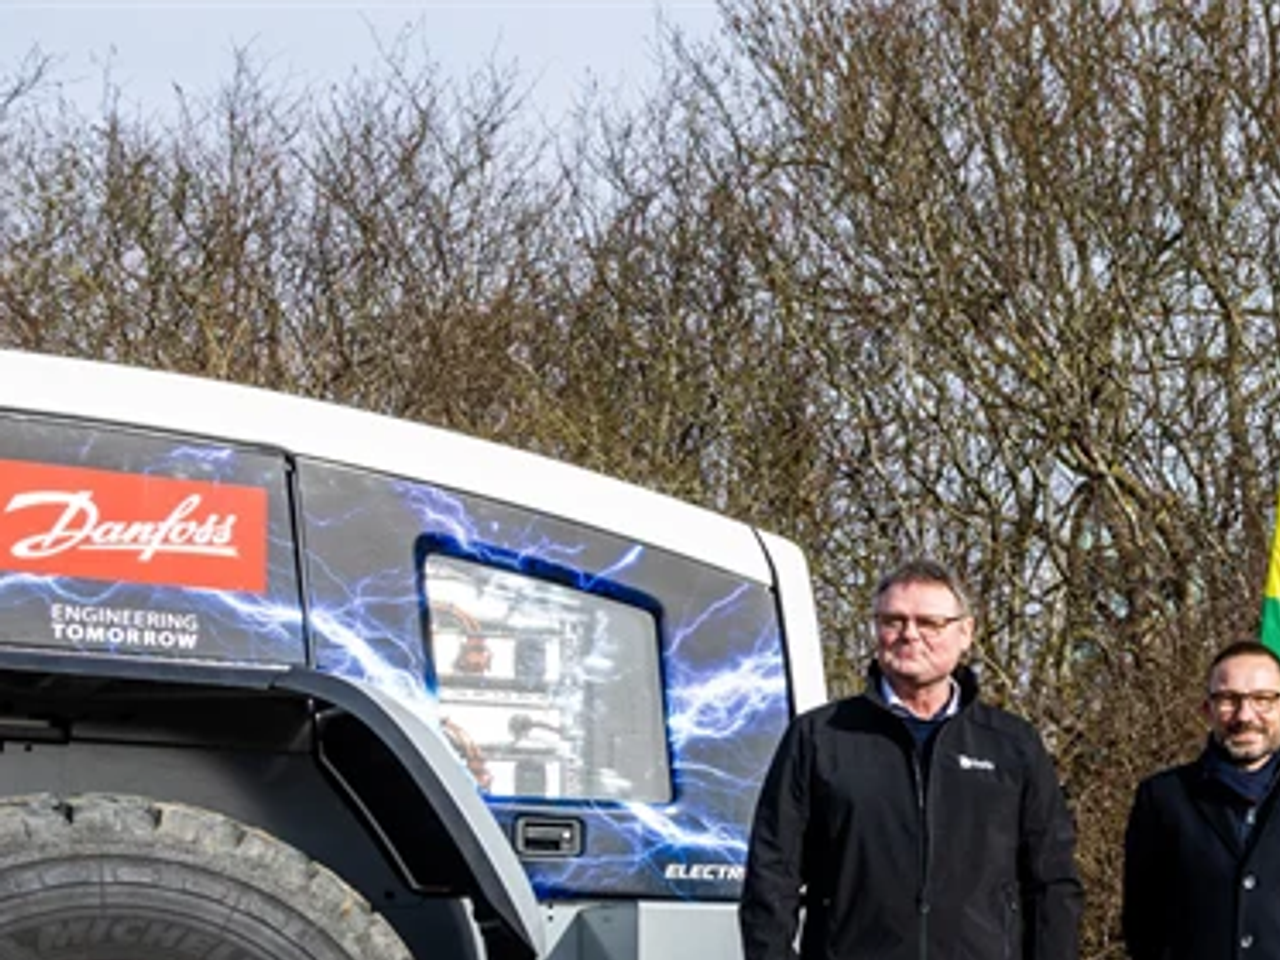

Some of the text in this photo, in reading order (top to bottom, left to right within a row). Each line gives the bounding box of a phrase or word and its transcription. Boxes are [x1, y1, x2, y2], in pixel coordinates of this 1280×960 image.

[4, 490, 239, 562] Danfoss
[51, 603, 198, 632] ENGINEERING
[52, 623, 198, 649] TOMORROW
[664, 864, 746, 880] ELECTR
